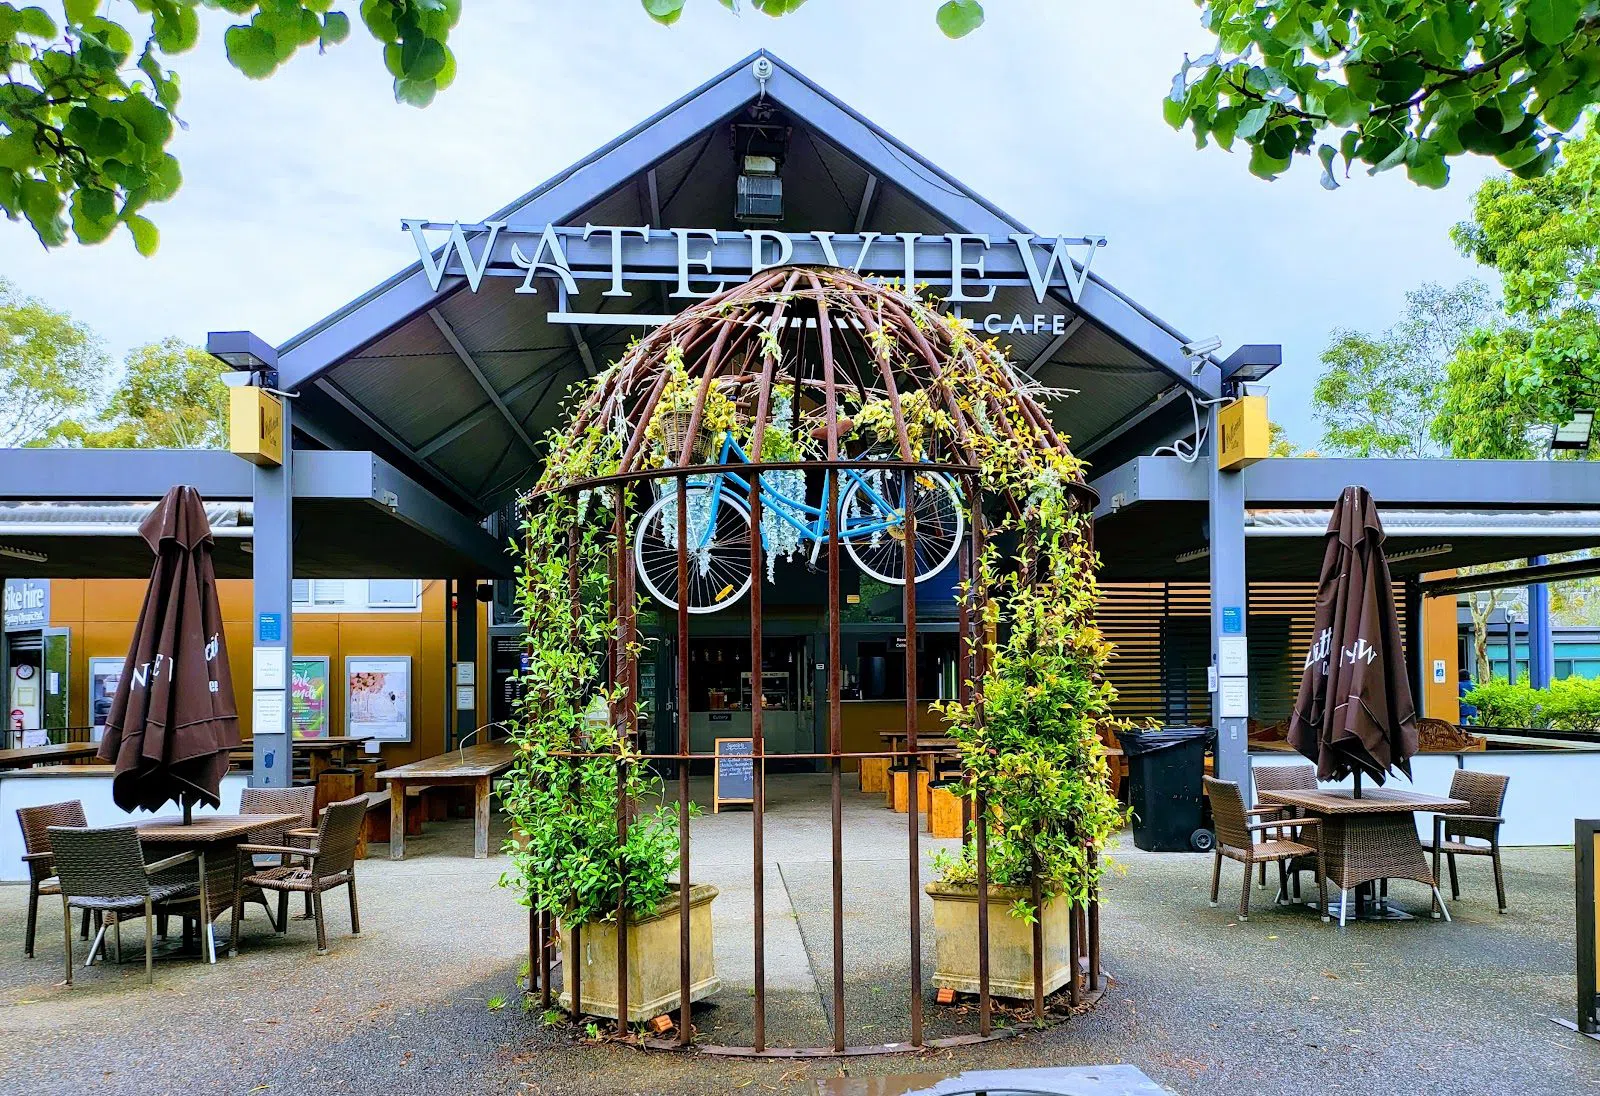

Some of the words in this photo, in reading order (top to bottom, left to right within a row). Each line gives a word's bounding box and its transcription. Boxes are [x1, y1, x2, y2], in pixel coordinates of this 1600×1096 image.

[400, 218, 1106, 305] WATERVIEW
[983, 313, 1065, 335] CAFE
[23, 582, 45, 609] hire
